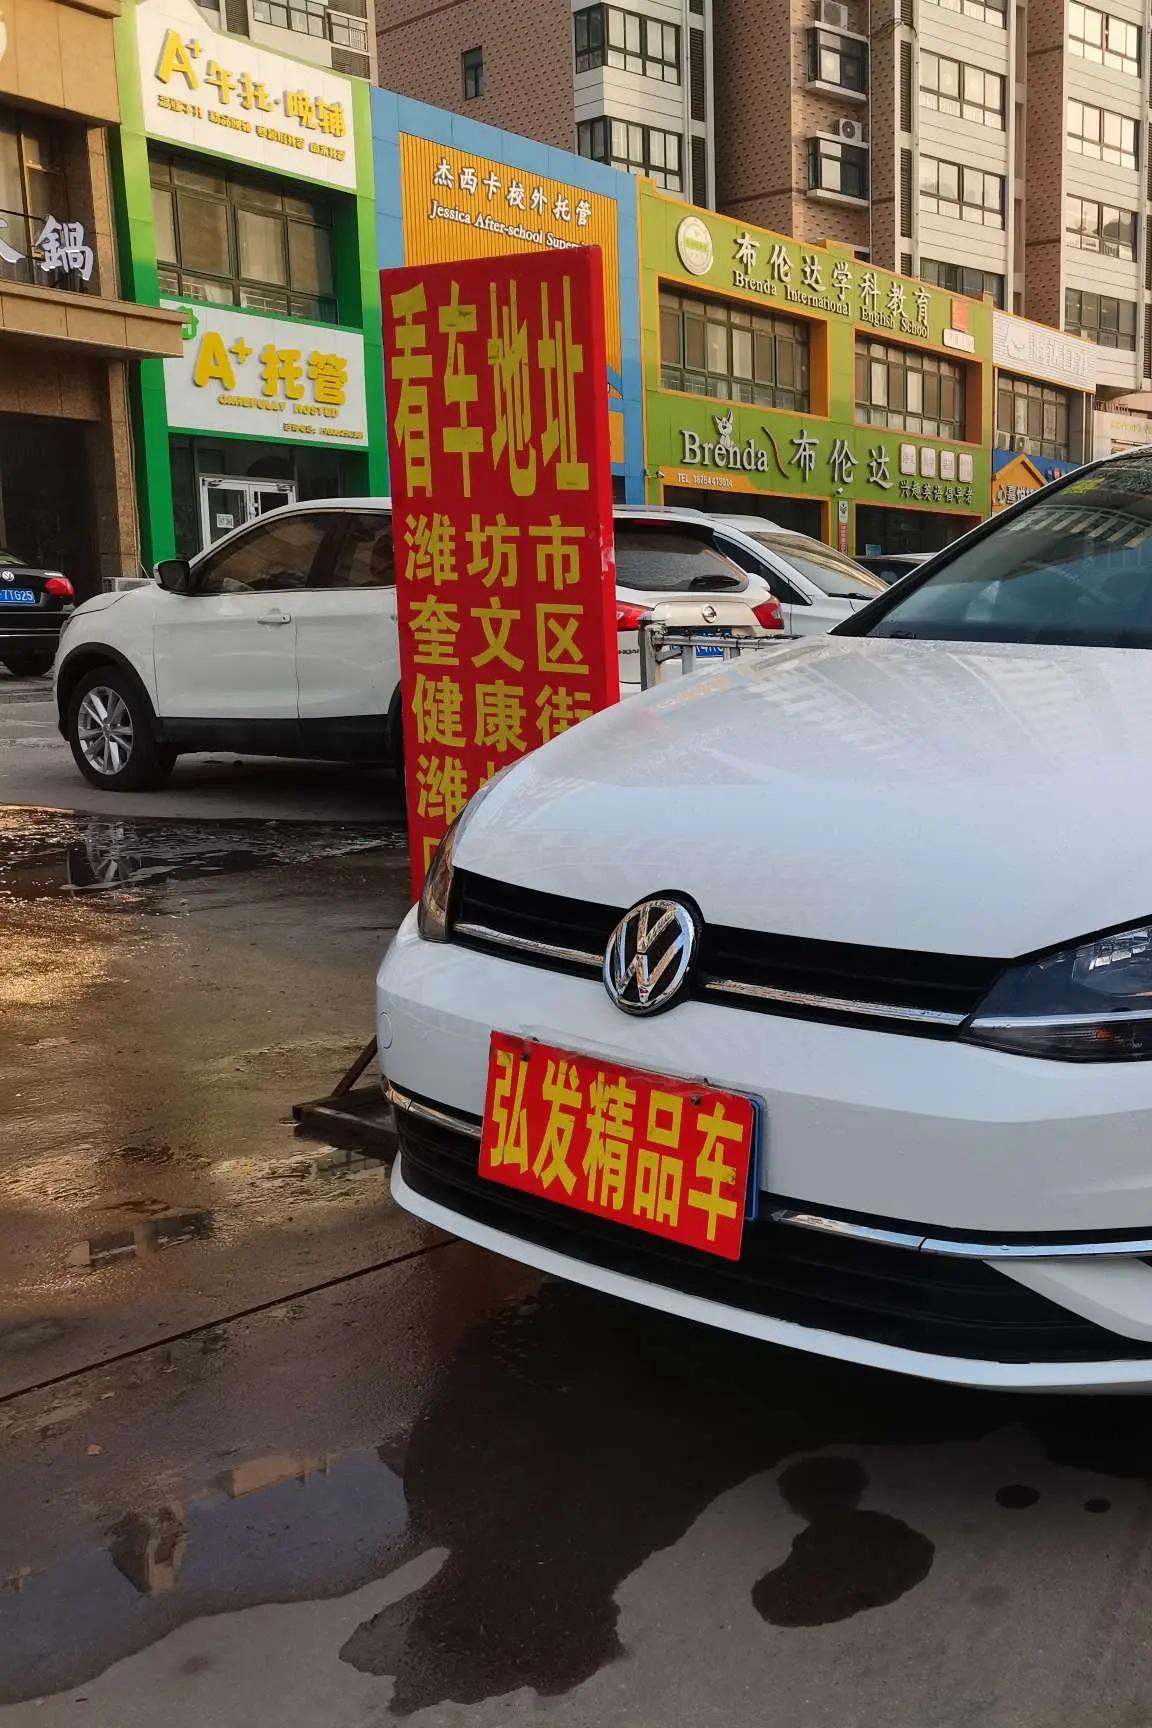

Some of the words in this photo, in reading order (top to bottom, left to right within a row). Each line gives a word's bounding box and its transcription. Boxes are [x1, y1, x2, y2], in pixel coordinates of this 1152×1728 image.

[430, 200, 471, 225] Jessica
[474, 213, 543, 244] After-school
[433, 158, 593, 227] 杰西卡校外托管
[733, 269, 777, 296] Brenda
[785, 284, 851, 317] International
[859, 306, 894, 329] English
[736, 233, 931, 325] 布伦达学科教育
[391, 275, 590, 498] 看车地址
[681, 430, 769, 473] Brenda
[791, 429, 894, 489] 布伦达
[403, 512, 586, 592] 潍坊市
[408, 595, 590, 676] 奎文区
[411, 672, 594, 753] 健康街
[487, 1047, 745, 1242] 弘发精品车
